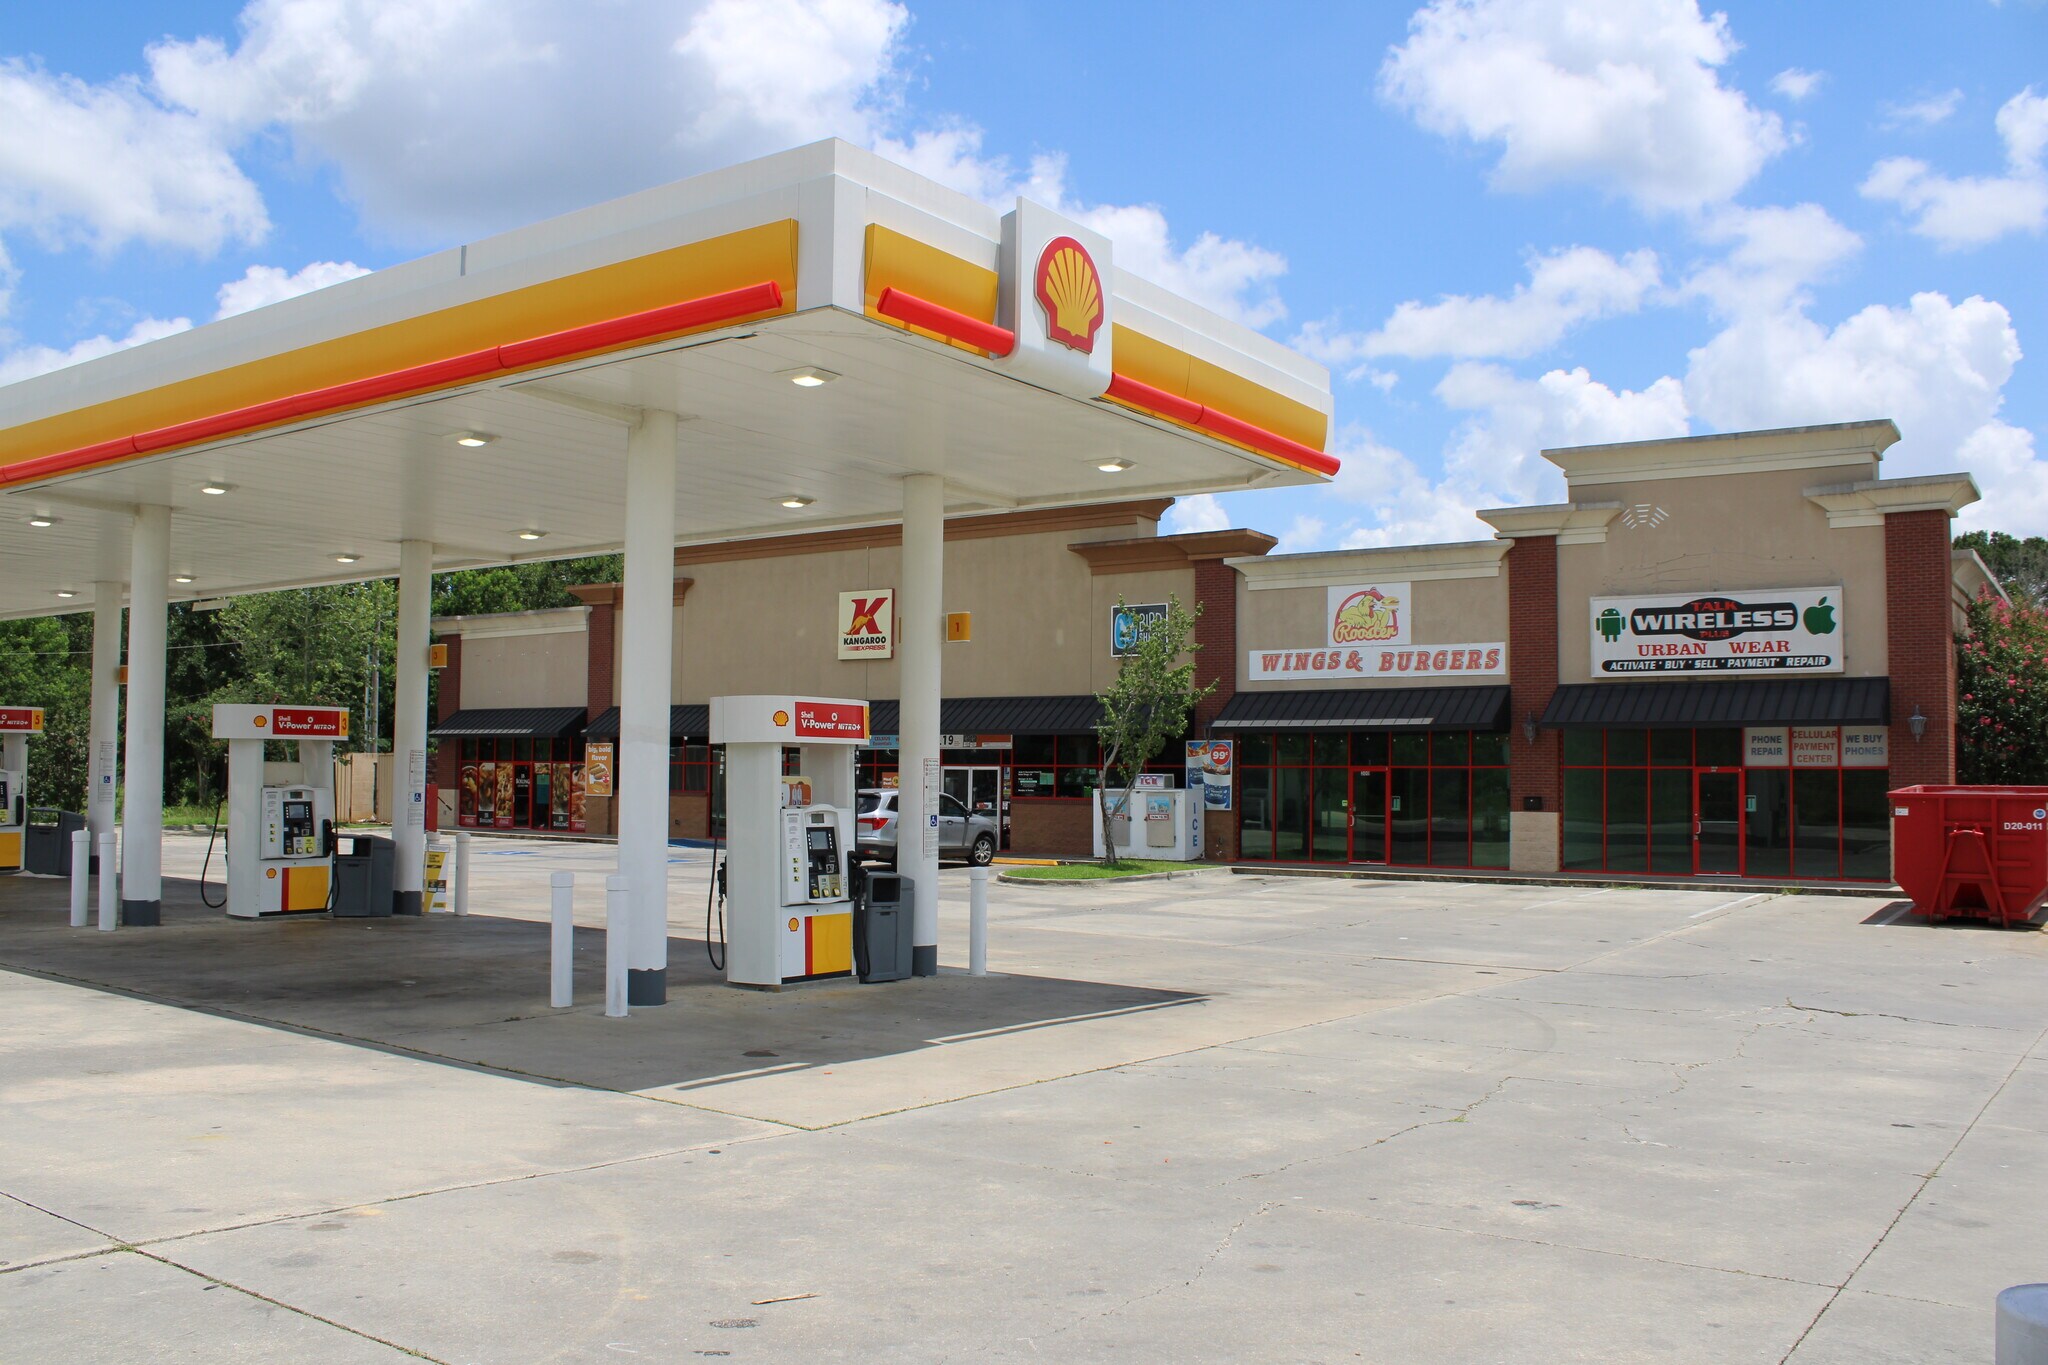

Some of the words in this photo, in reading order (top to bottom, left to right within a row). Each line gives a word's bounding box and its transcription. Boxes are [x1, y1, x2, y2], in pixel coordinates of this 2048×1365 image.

[1692, 601, 1738, 612] TALK
[1633, 610, 1794, 631] WIRELESS
[1335, 619, 1398, 642] Rooster
[843, 636, 886, 645] KANGAROO
[1637, 643, 1708, 656] URBAN
[1729, 640, 1791, 654] WEAR
[1379, 649, 1501, 672] BURGERS
[1610, 660, 1656, 670] ACTIVATE
[1664, 659, 1686, 669] BUY
[1694, 658, 1718, 668] SELL
[1727, 657, 1777, 668] PAYMENT
[1786, 656, 1827, 667] REPAIR
[801, 711, 814, 719] Shell
[35, 715, 40, 725] 5
[342, 718, 347, 730] 3
[278, 721, 312, 729] V-Power
[801, 719, 836, 730] V-Power
[838, 723, 861, 731] NITRO+
[1792, 730, 1837, 739] CELLULAR
[1846, 735, 1861, 743] WE
[1863, 734, 1883, 743] BUY
[1751, 735, 1782, 744] PHONE
[1793, 742, 1836, 751] PAYMENT
[1845, 747, 1884, 755] PHONES
[1751, 747, 1783, 756] REPAIR
[1797, 754, 1832, 763] CENTER
[1140, 776, 1159, 785] ICE
[2003, 822, 2043, 830] D20-011
